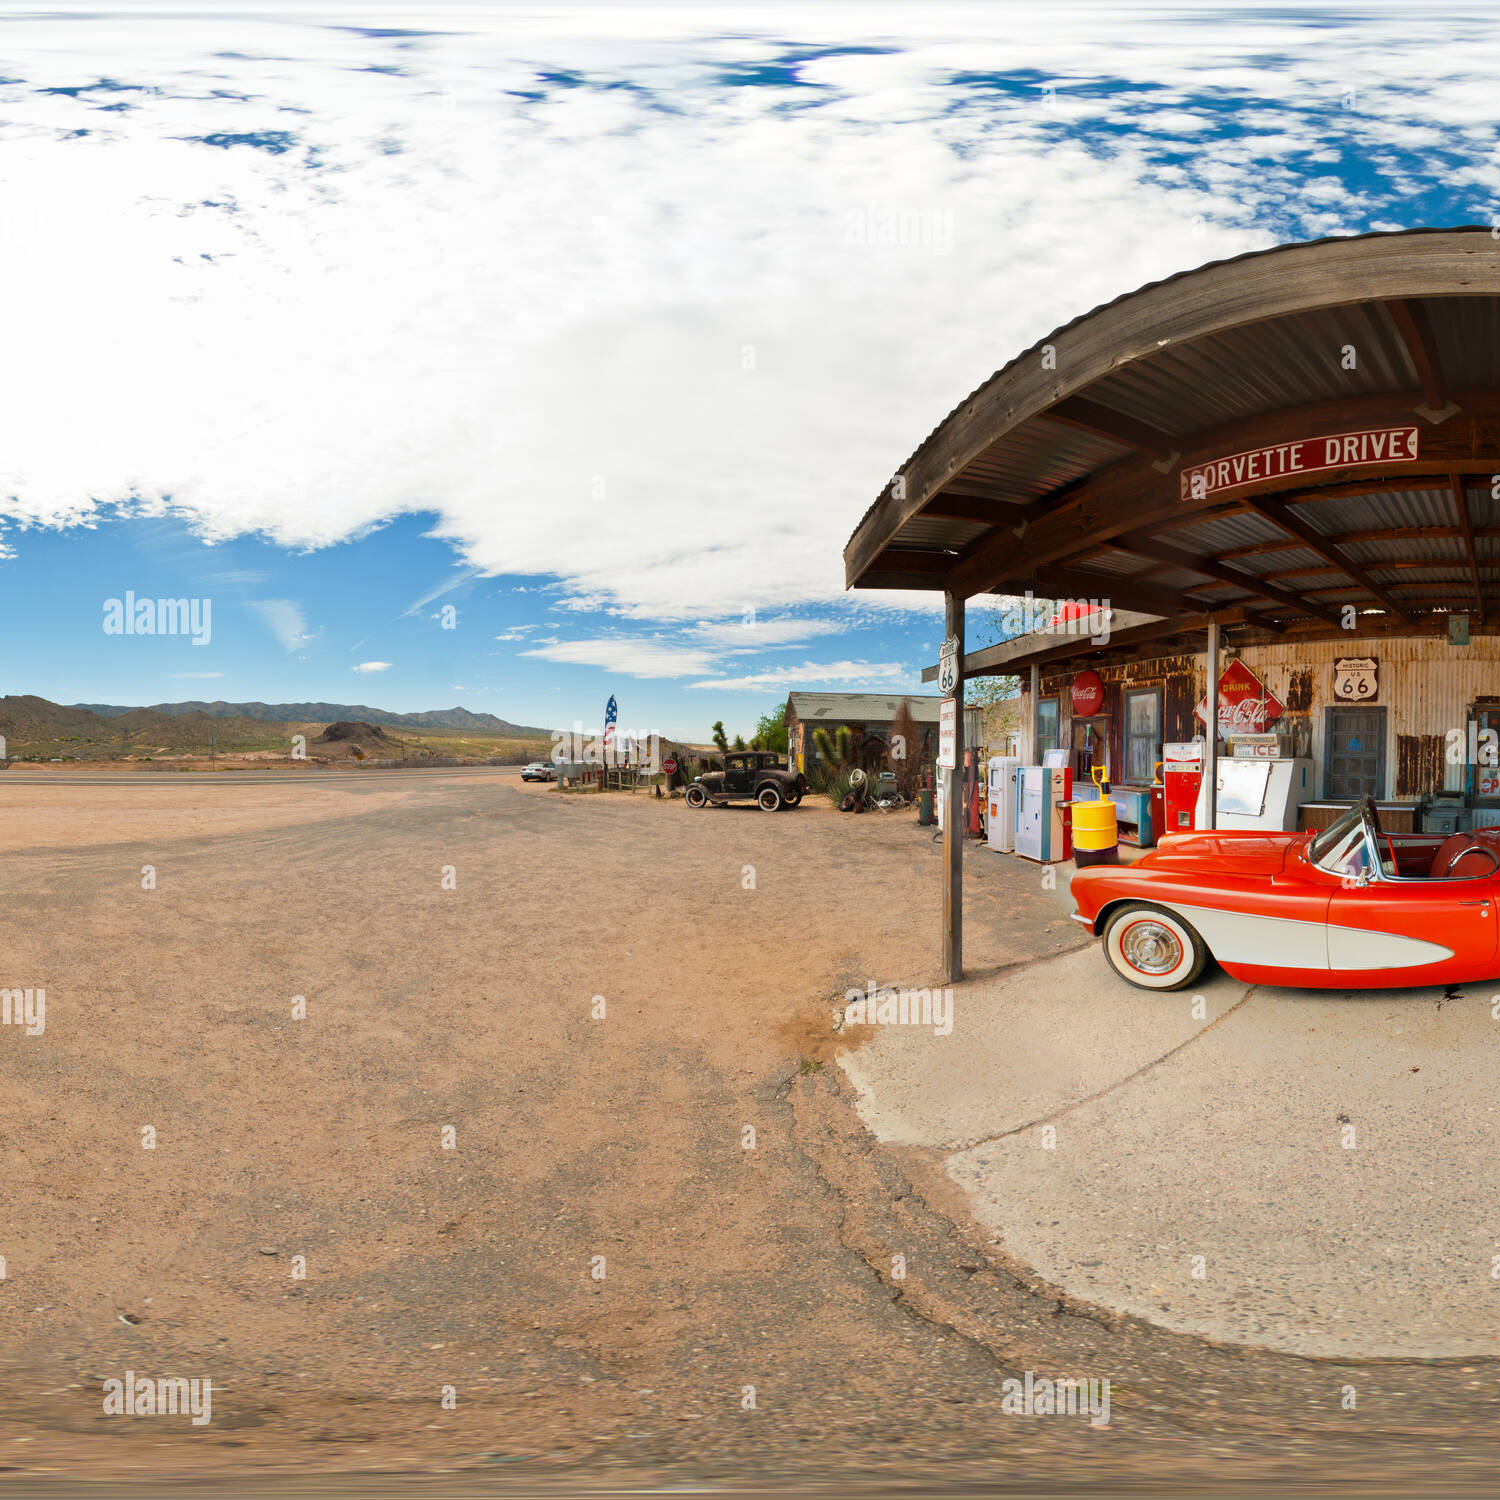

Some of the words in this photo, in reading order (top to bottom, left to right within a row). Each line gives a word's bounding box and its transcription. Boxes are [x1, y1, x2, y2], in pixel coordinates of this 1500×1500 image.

[1325, 431, 1405, 466] DRIVE
[941, 643, 954, 656] ROUTE
[941, 668, 953, 689] 66
[1222, 682, 1251, 693] DRINK
[1342, 678, 1369, 694] 66
[1252, 745, 1277, 756] ICE
